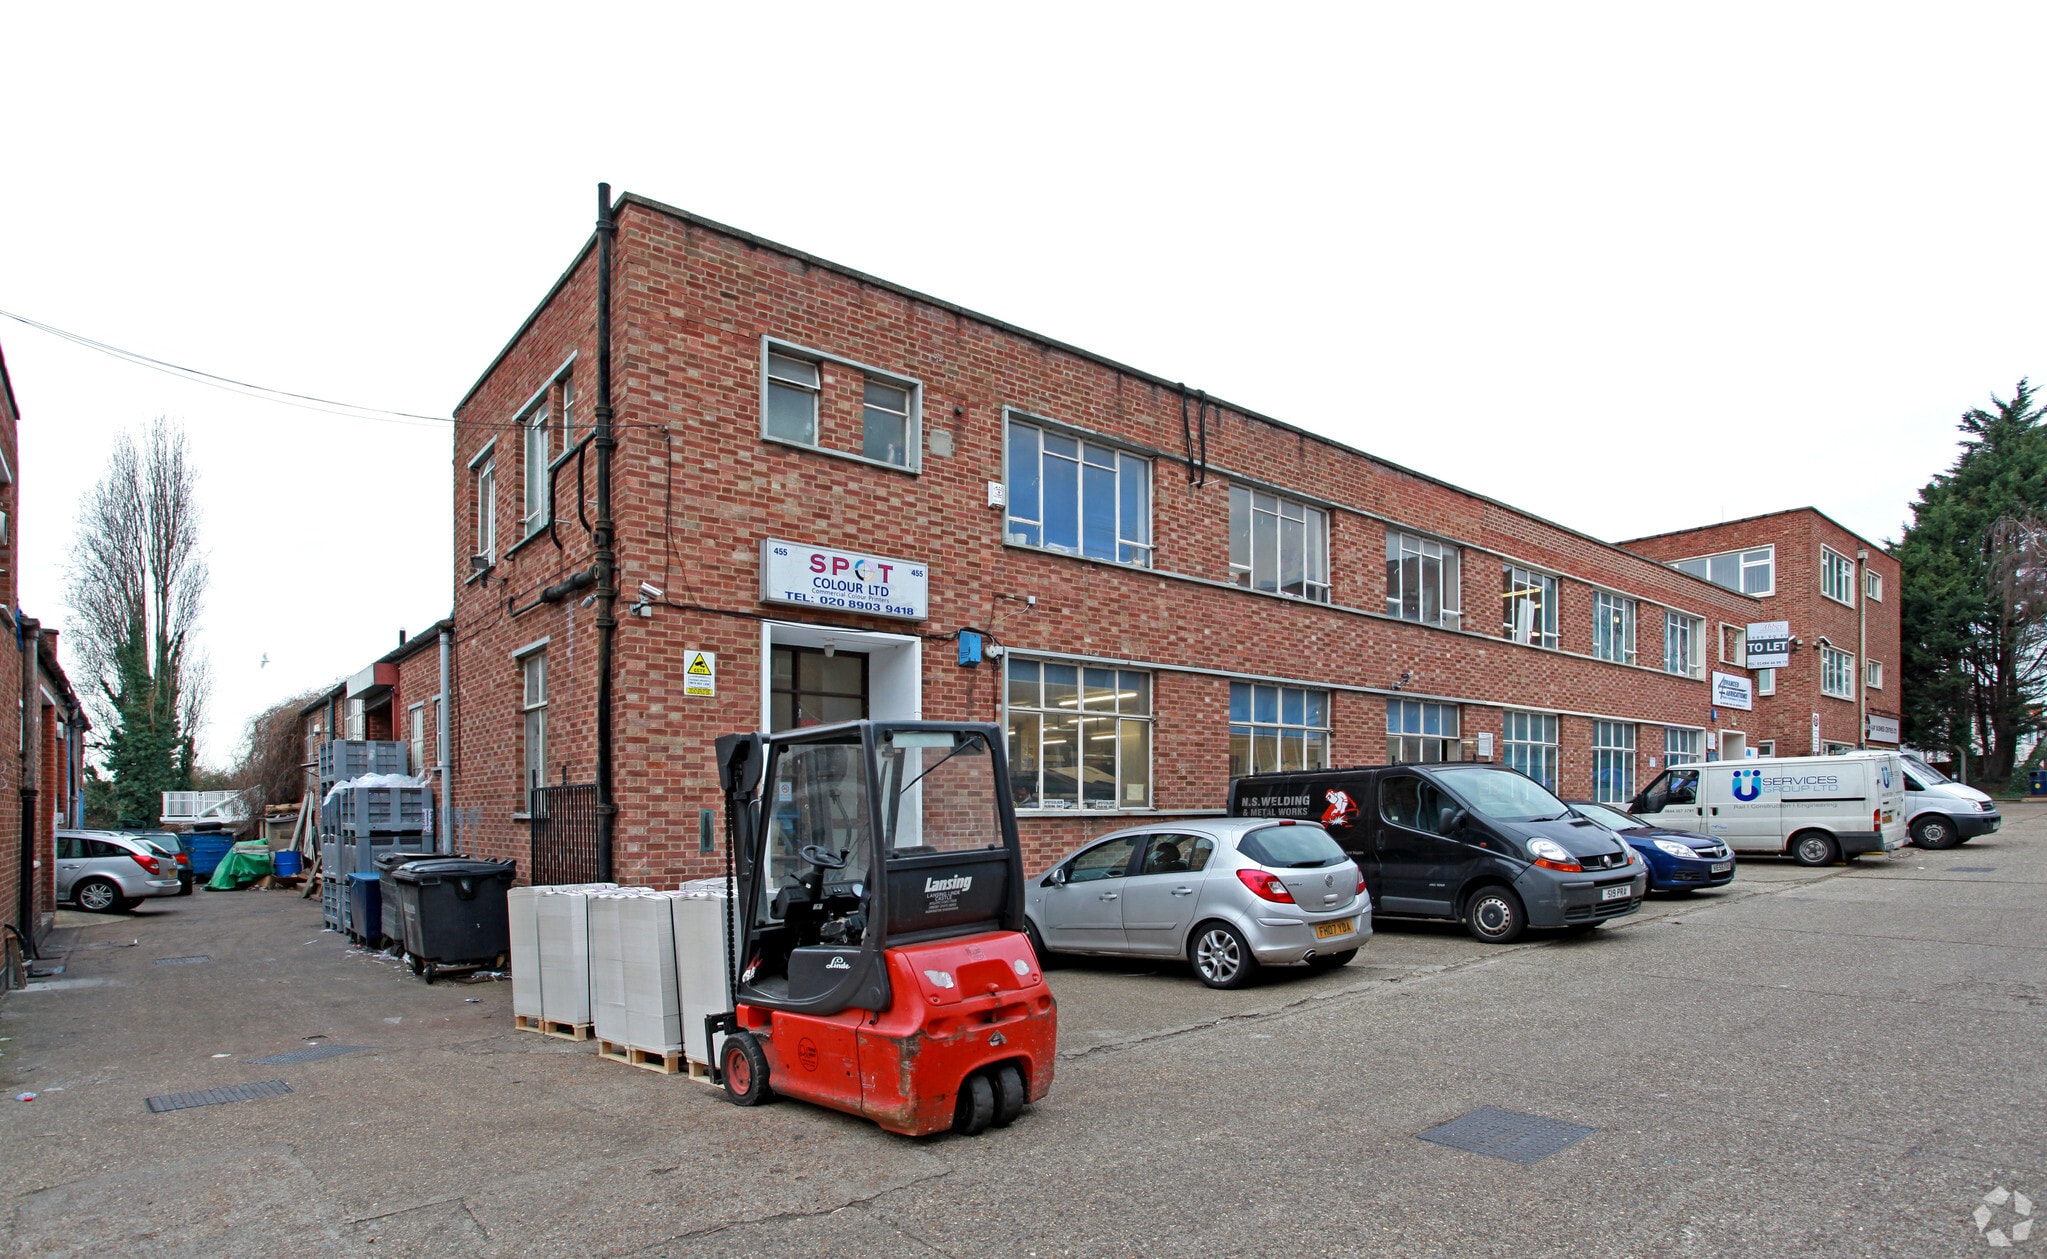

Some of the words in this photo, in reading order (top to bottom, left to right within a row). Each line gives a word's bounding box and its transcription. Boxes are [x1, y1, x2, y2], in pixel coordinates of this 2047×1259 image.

[773, 547, 788, 556] 455
[809, 553, 893, 584] SPOT
[911, 569, 924, 578] 455
[813, 577, 863, 594] COLOUR
[868, 585, 889, 597] LTD
[811, 587, 846, 598] Commercial
[847, 592, 867, 600] Colour
[785, 591, 815, 603] TEL:
[819, 596, 845, 607] 020
[848, 600, 881, 612] 8903
[885, 605, 914, 616] 9418
[1747, 643, 1764, 653] TO
[1766, 641, 1788, 652] LET
[1762, 775, 1838, 786] SERVICES
[1763, 785, 1810, 793] GROUP
[1813, 784, 1839, 792] LTD
[1242, 808, 1248, 816] &
[1250, 808, 1277, 817] METAL
[1278, 807, 1308, 816] WORKS
[1796, 802, 1838, 810] Engineering
[924, 874, 973, 892] Lansing
[1318, 923, 1336, 936] FH07
[825, 956, 851, 970] Linde
